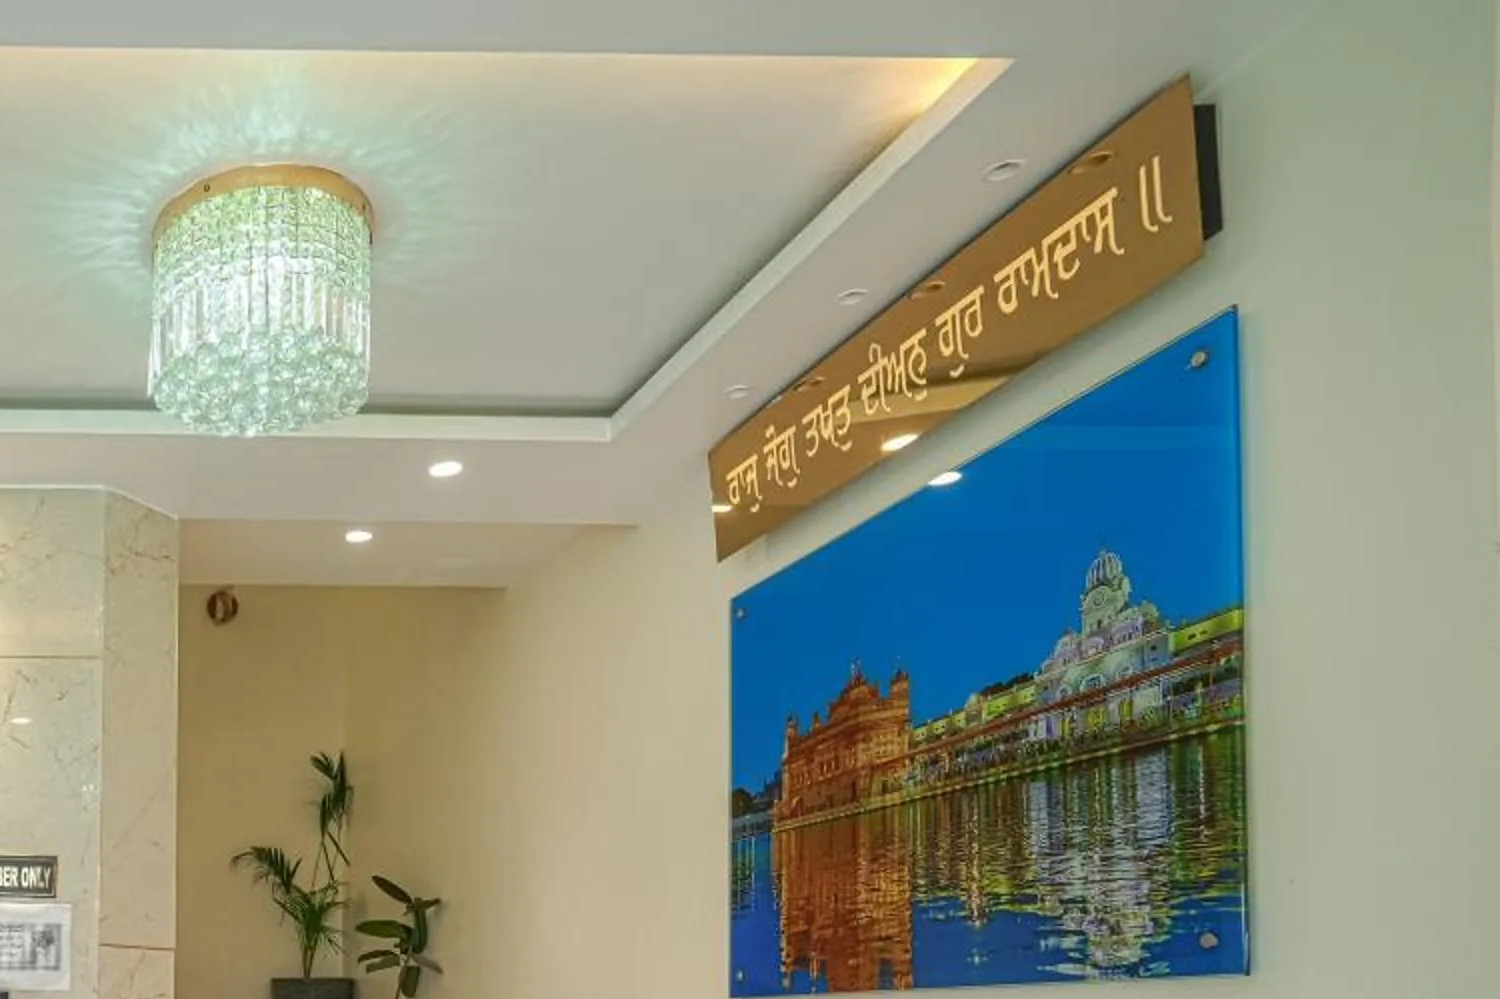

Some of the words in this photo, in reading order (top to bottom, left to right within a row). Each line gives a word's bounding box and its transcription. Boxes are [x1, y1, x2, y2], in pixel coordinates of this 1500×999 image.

[726, 454, 763, 513] ਰਾਜੁ
[763, 424, 800, 488] ਜੋਗੁ
[802, 384, 852, 457] ਤਖਤੁ
[935, 285, 985, 378] ਗੁਰ
[993, 186, 1125, 314] ਰਾਮਦਾਸ
[21, 866, 51, 888] ONLY
